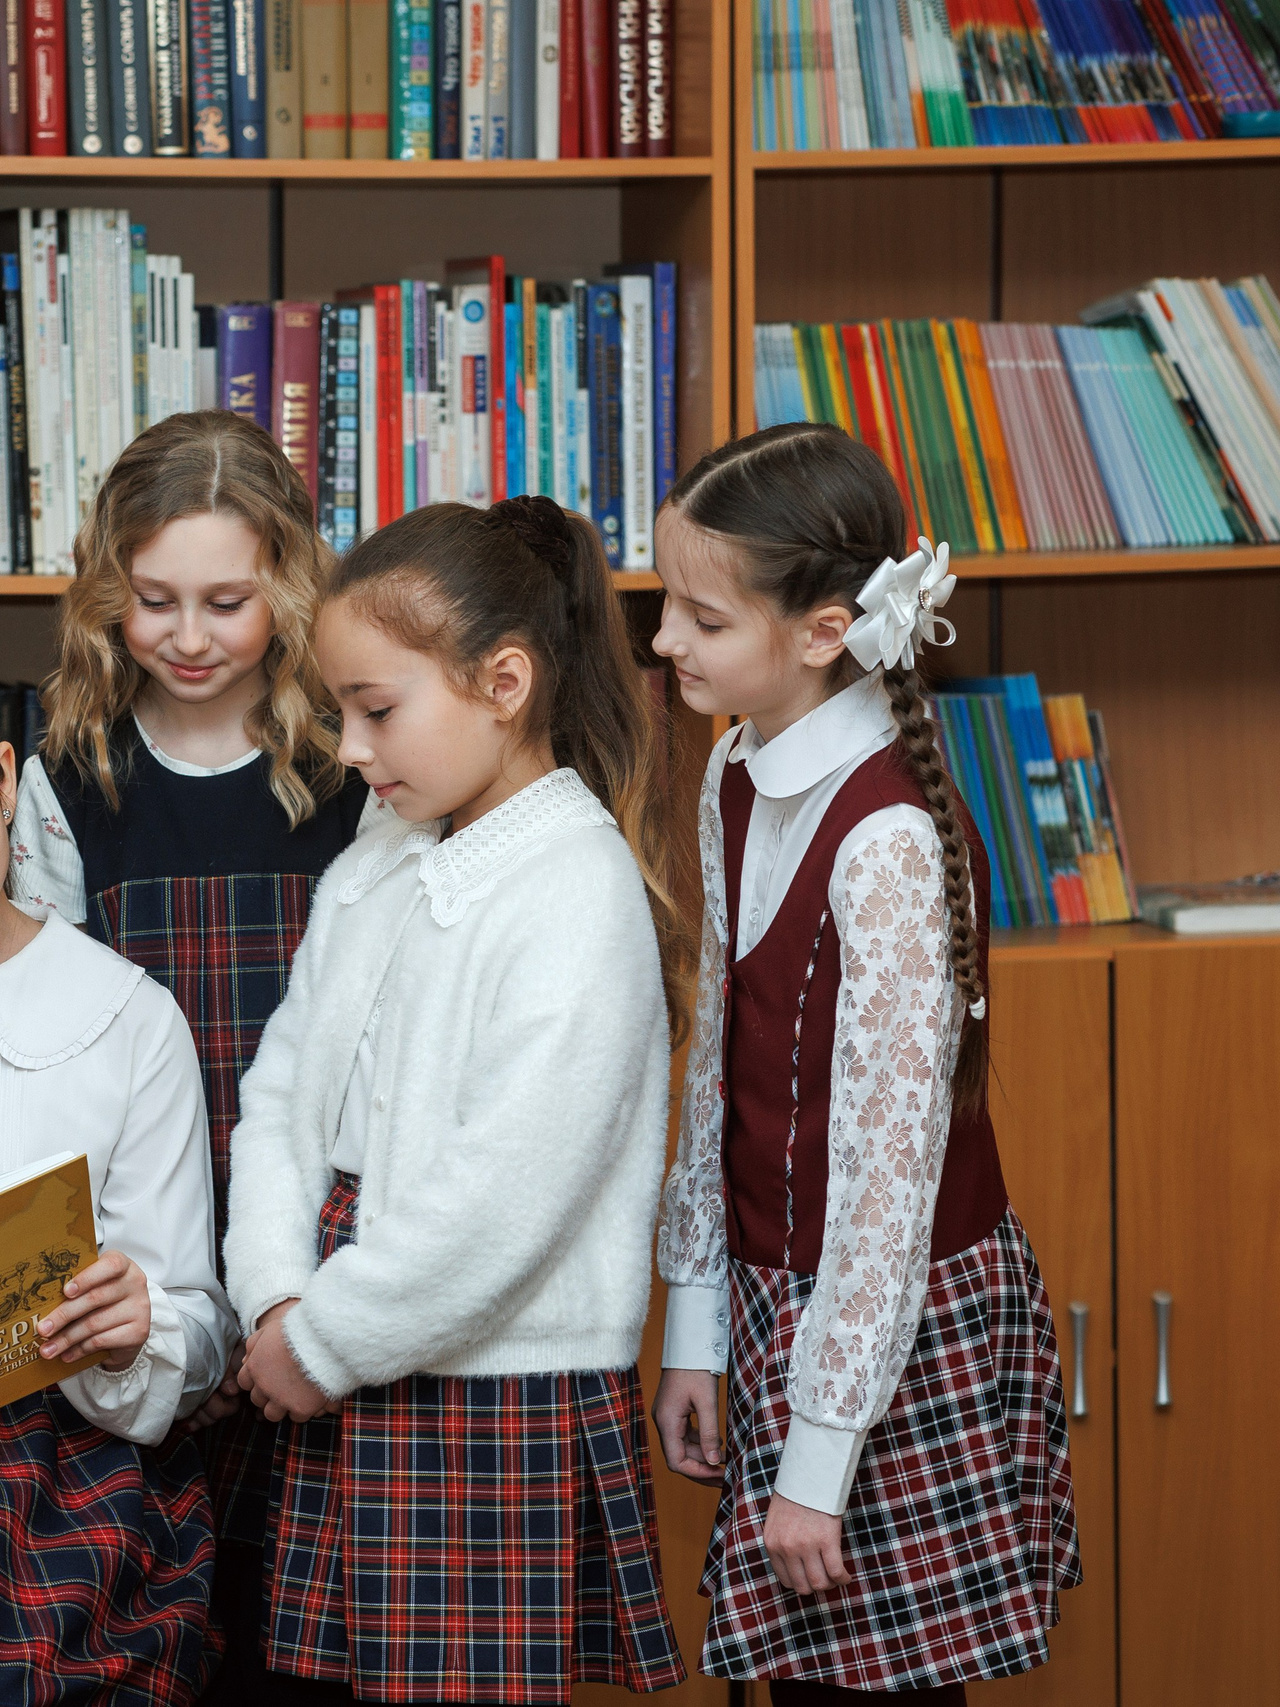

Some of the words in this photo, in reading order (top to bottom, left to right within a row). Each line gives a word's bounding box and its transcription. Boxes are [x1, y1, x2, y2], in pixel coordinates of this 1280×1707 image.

[192, 0, 211, 99] РУССКИ
[211, 0, 229, 99] ЭНЦИКЛ
[442, 56, 459, 90] Что
[468, 55, 483, 87] Что
[618, 43, 642, 143] КРАСНАЯ
[646, 38, 669, 139] КРАСНАЯ
[281, 380, 309, 481] ИМИЯ
